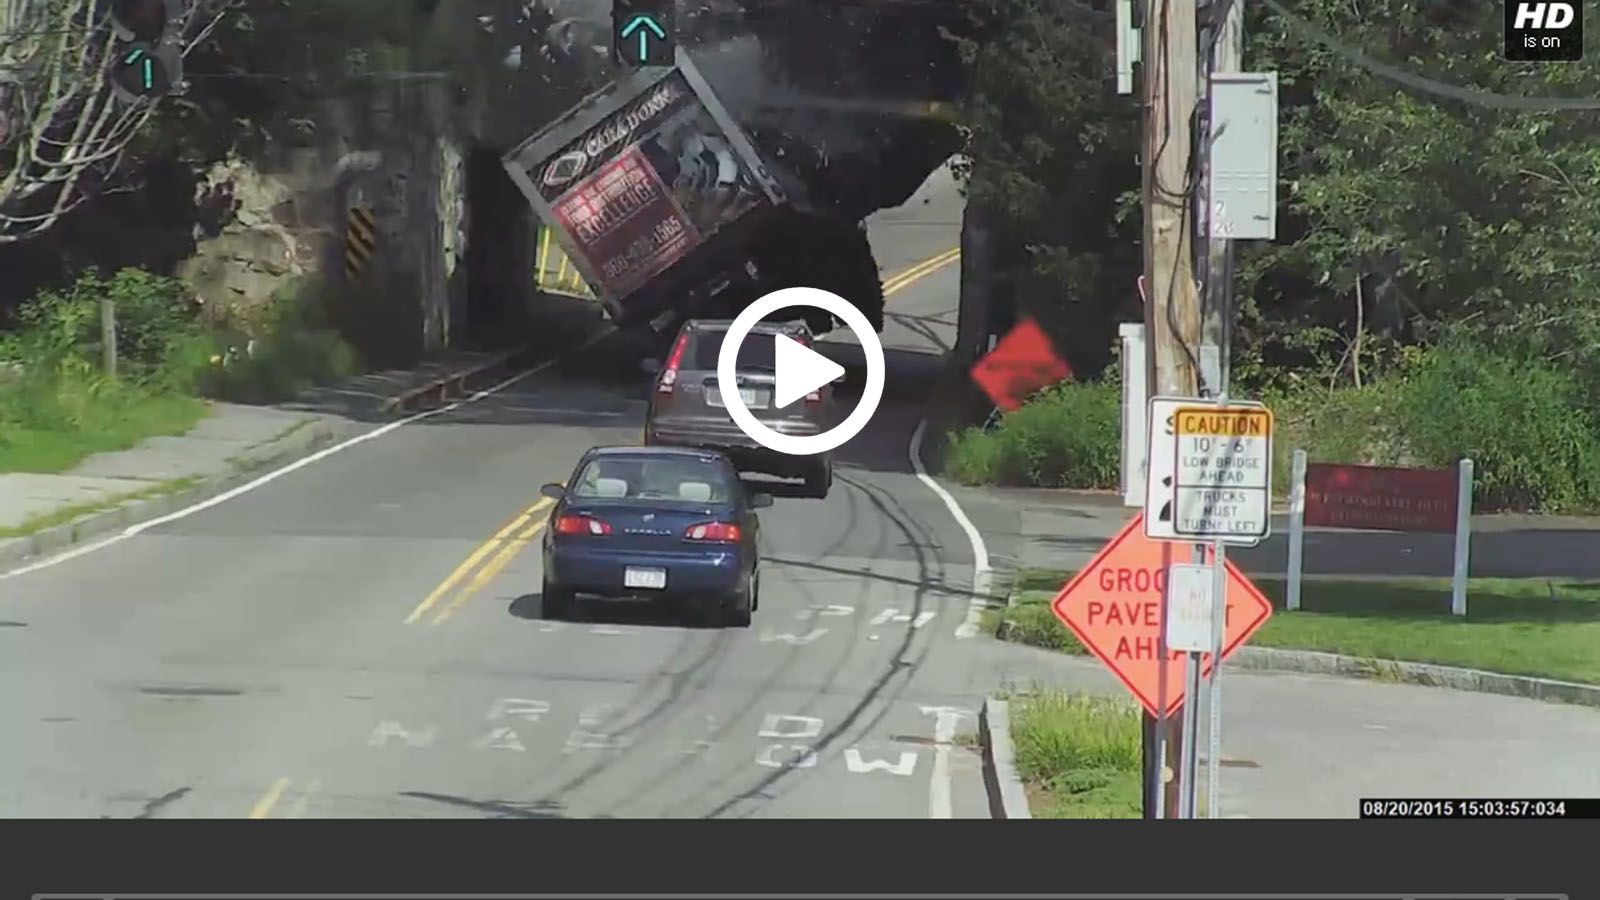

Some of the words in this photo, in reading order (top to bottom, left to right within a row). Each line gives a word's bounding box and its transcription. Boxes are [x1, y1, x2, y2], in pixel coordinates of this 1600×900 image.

[575, 178, 656, 244] EXCELLENCE
[1185, 415, 1260, 434] CAUTION
[1183, 456, 1209, 468] LOW
[1216, 457, 1260, 469] BRIDGE
[1199, 470, 1244, 482] AHEAD
[1197, 490, 1246, 502] TRUCKS
[1203, 505, 1238, 517] MUST
[1227, 520, 1256, 532] LEFT
